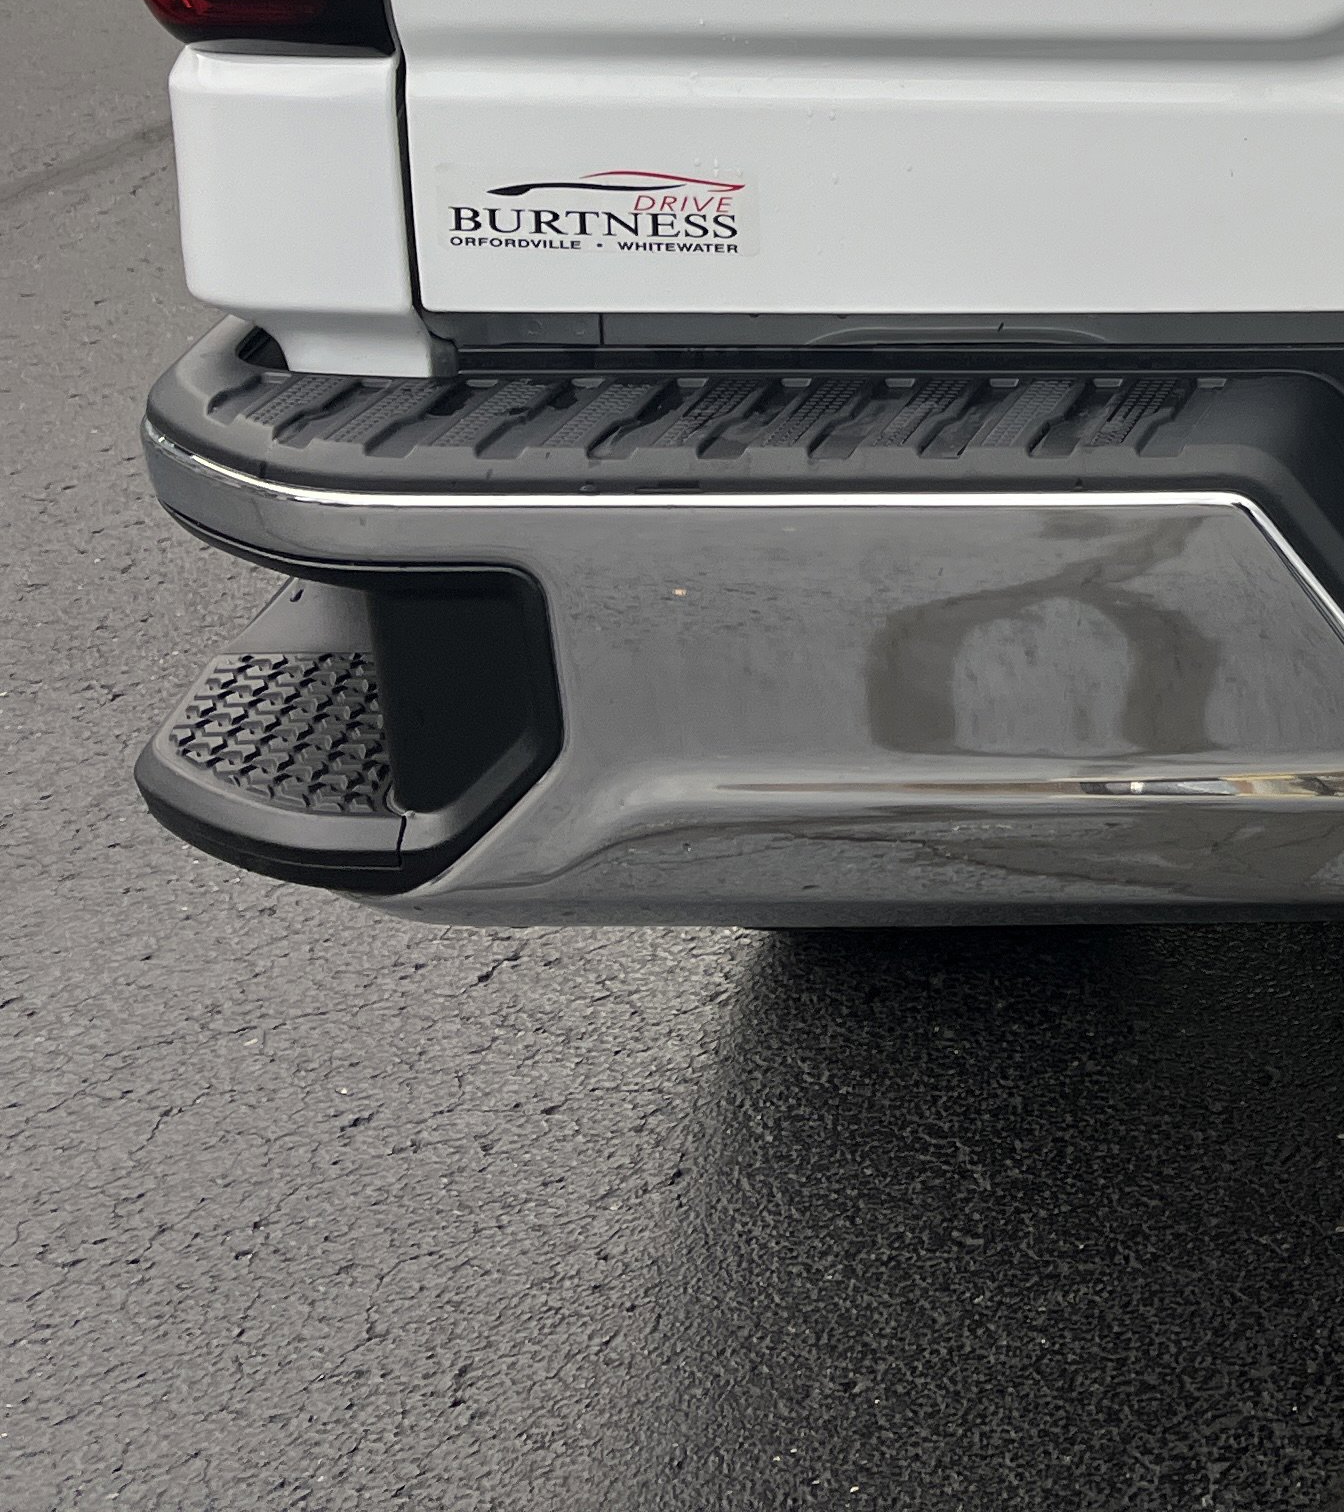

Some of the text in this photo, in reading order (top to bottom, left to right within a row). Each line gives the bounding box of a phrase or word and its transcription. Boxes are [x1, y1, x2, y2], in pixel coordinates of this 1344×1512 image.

[633, 194, 734, 213] DRIVE
[449, 206, 739, 239] BURTNESS
[450, 237, 739, 254] ORFORDVILLE WHITEWATER
